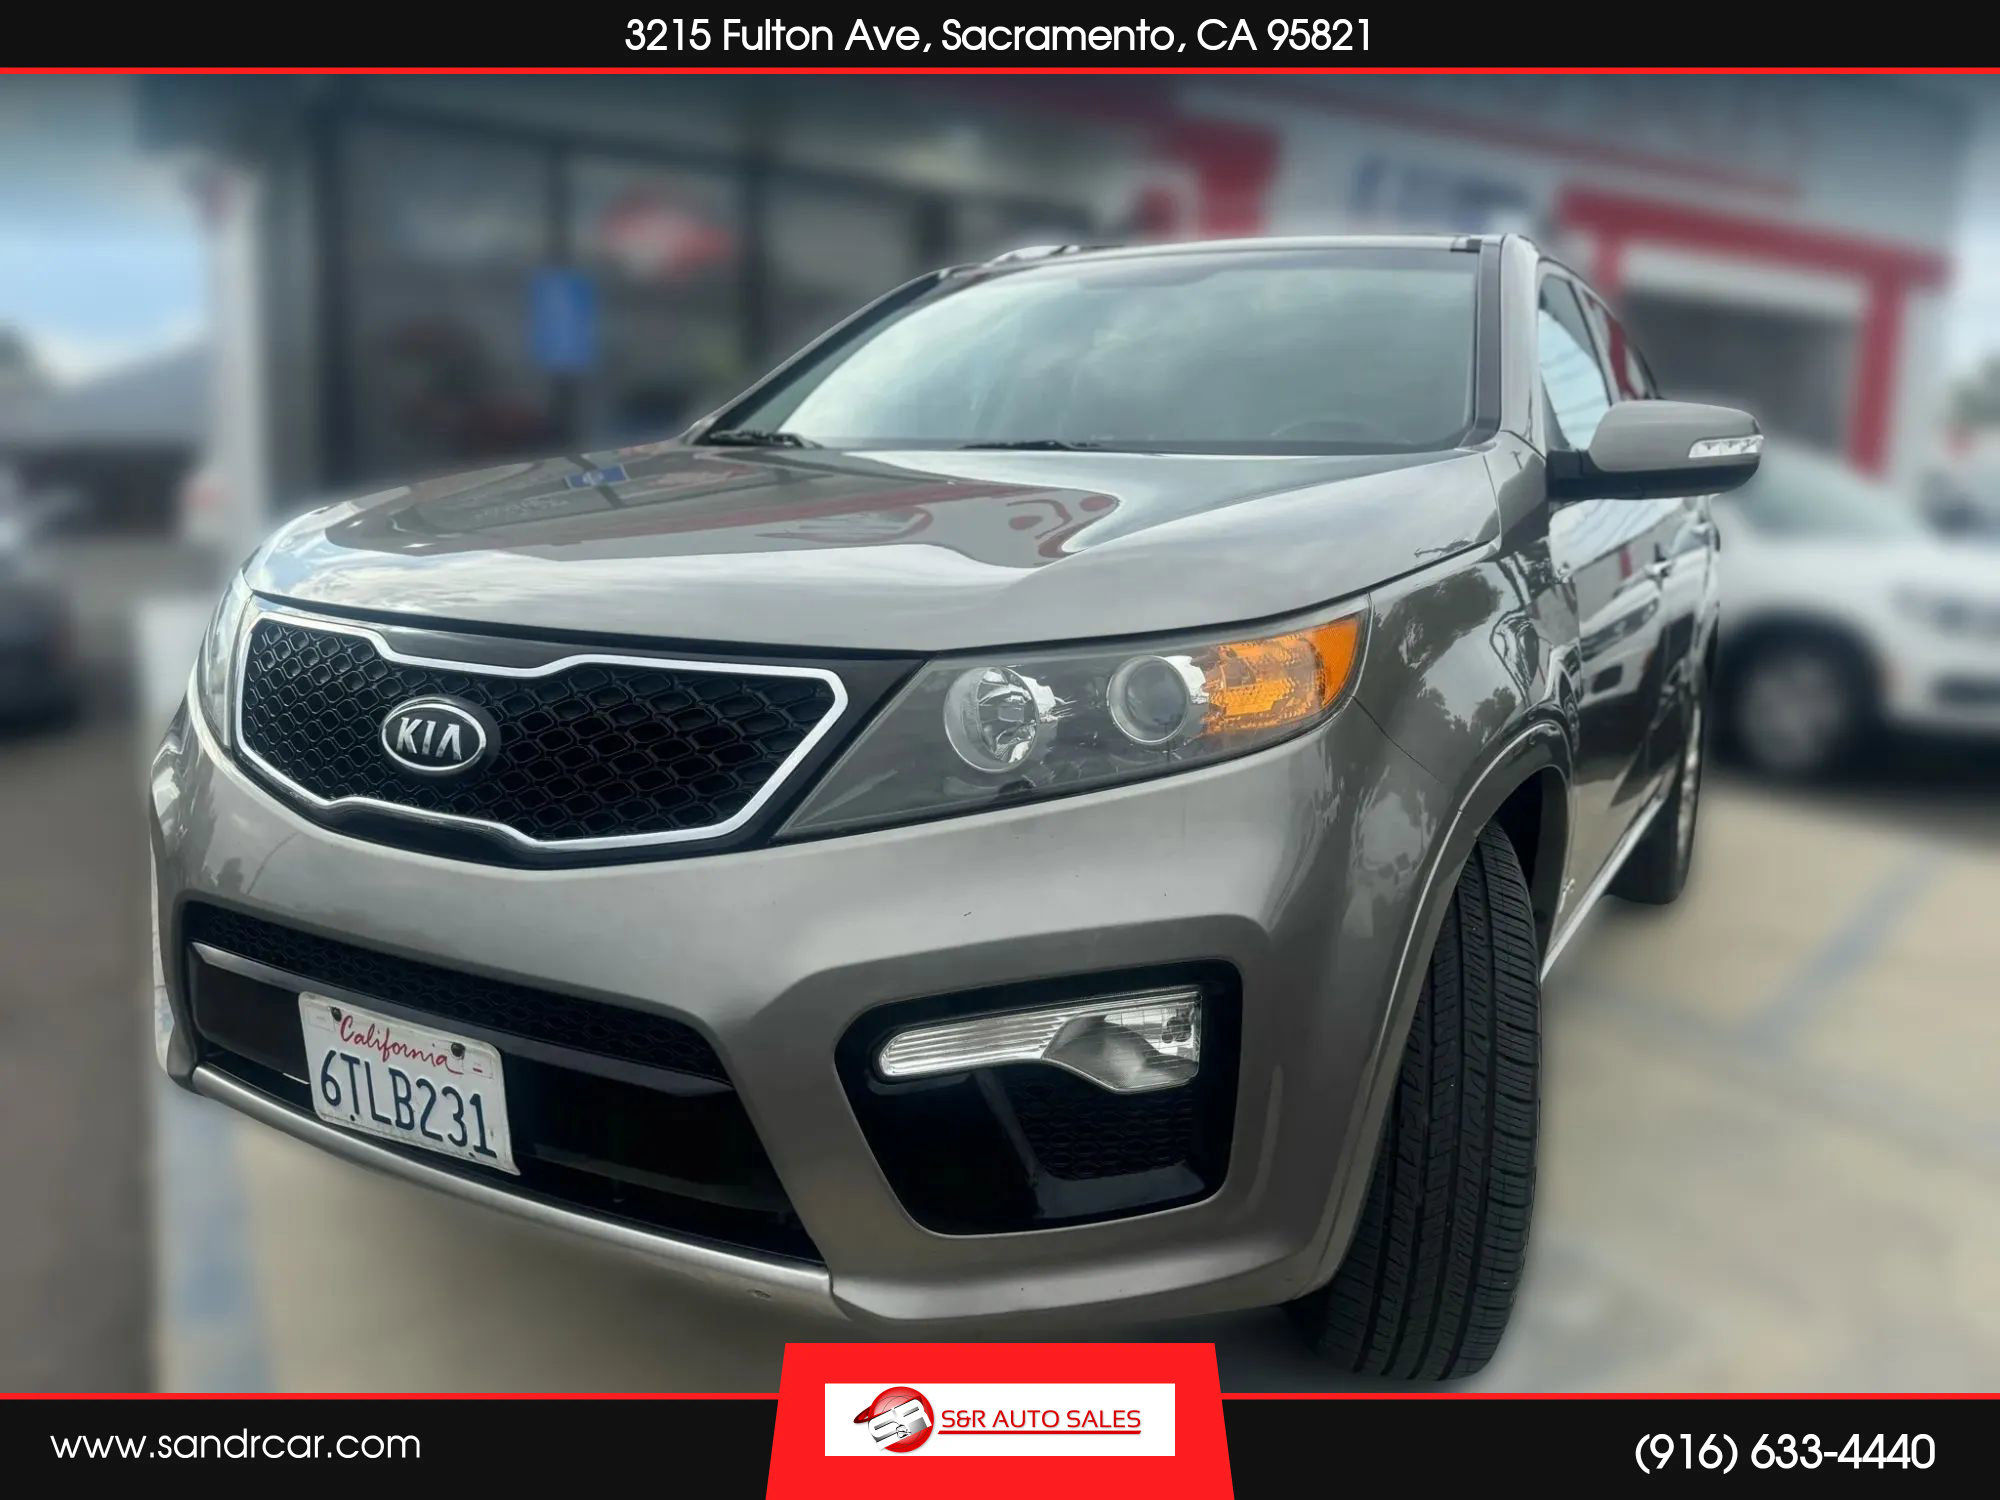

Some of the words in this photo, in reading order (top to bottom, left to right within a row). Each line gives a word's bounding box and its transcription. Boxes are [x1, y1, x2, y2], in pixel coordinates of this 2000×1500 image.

[396, 716, 462, 761] KIA
[340, 1015, 464, 1075] California
[320, 1049, 498, 1159] 6TLB231
